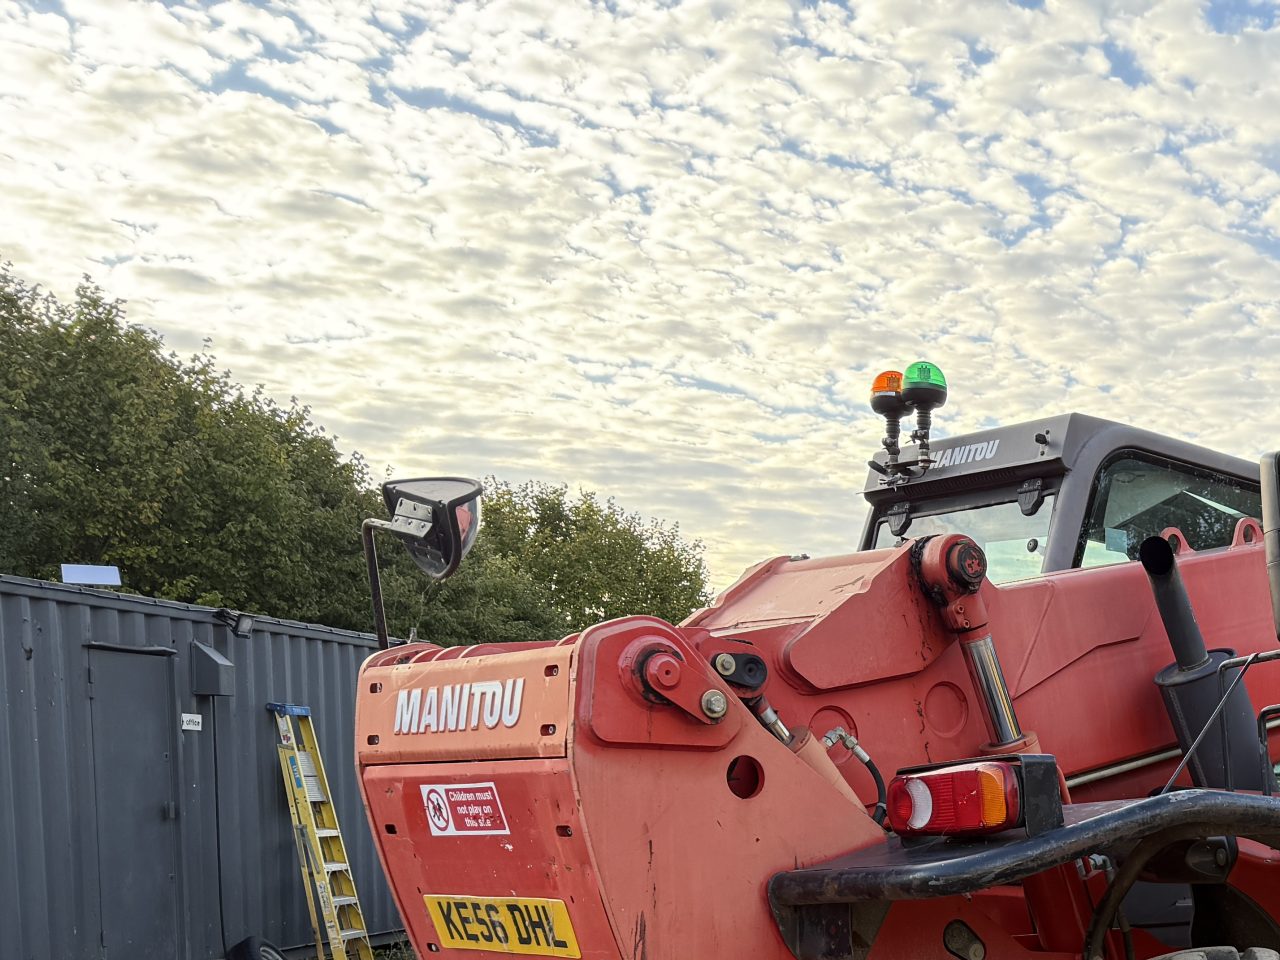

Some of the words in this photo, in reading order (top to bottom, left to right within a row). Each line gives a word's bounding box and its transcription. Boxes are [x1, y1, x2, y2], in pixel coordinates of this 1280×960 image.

[393, 677, 525, 735] MANITOU
[448, 791, 475, 802] Children
[475, 790, 493, 801] must
[456, 805, 468, 814] not
[468, 804, 482, 816] play
[482, 805, 493, 814] on
[464, 817, 478, 827] this
[437, 901, 509, 944] KE56
[506, 904, 568, 948] DHL
